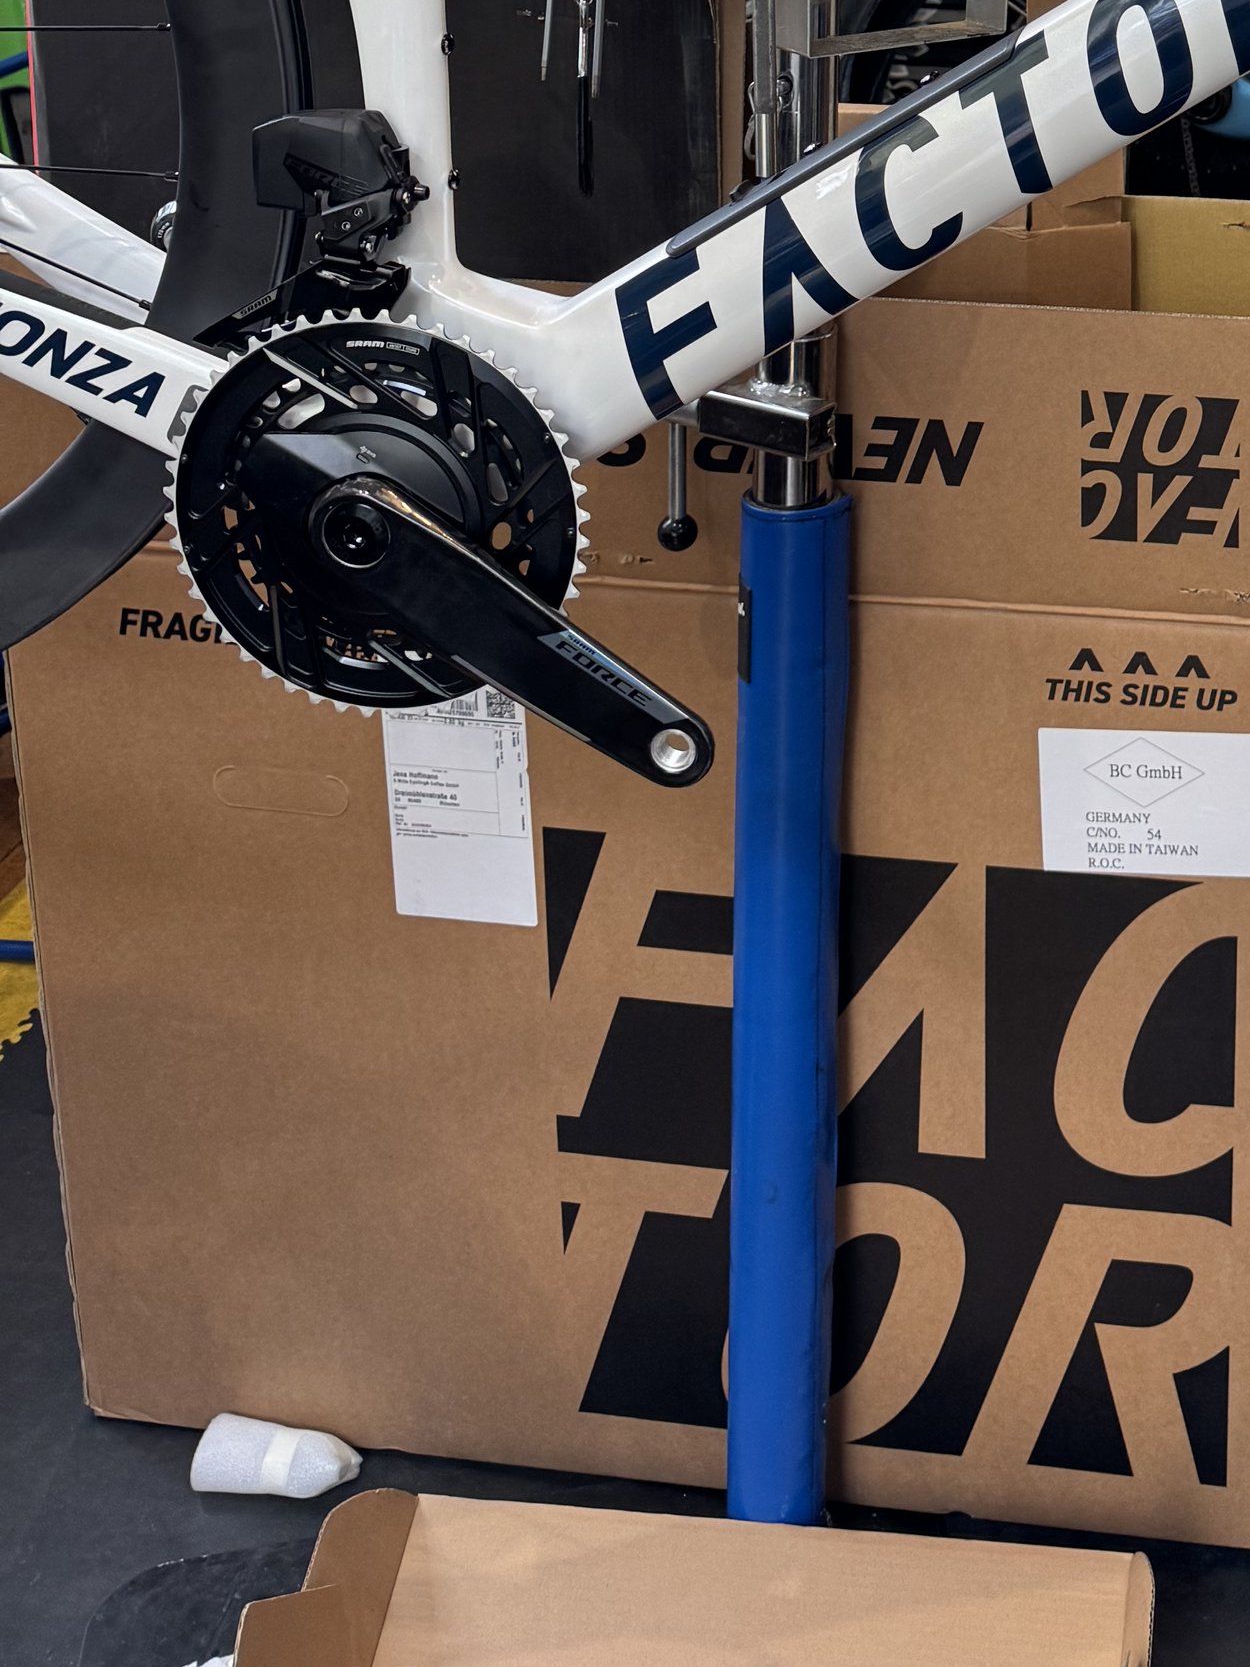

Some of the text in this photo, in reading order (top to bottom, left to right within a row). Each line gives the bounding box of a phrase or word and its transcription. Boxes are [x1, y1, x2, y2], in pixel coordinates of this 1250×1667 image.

[239, 294, 272, 316] SRAM
[346, 340, 385, 349] SRAM
[0, 302, 166, 418] ONZA
[556, 640, 654, 708] FORCE
[1045, 678, 1238, 712] THIS SIDE UP
[1109, 764, 1182, 779] BC GmbH
[1086, 811, 1151, 824] GERMANY
[1086, 827, 1162, 840] C/NO. 54
[1087, 842, 1199, 856] MADE IN TAIWAN
[1088, 857, 1125, 870] R.O.C.
